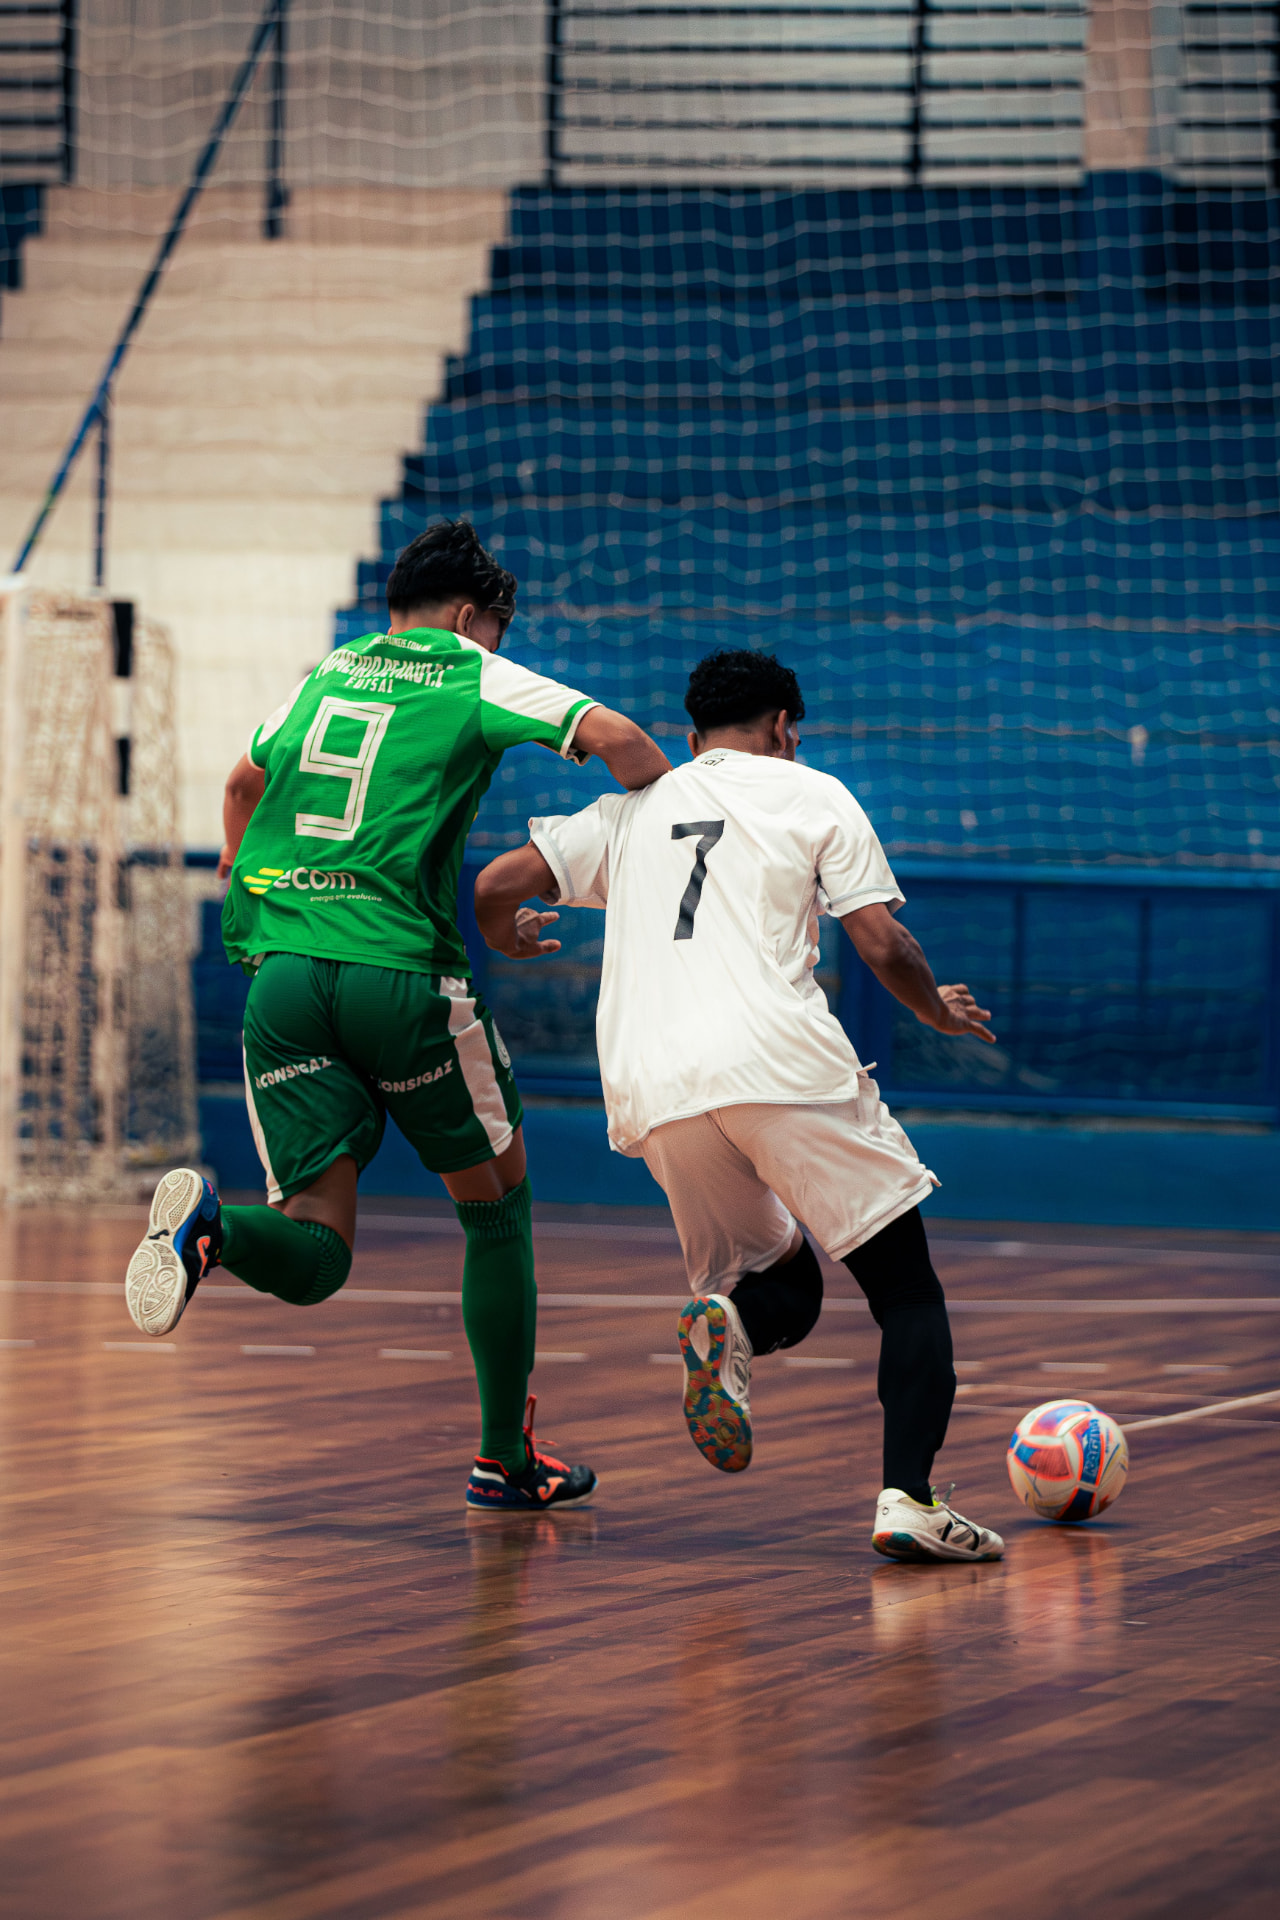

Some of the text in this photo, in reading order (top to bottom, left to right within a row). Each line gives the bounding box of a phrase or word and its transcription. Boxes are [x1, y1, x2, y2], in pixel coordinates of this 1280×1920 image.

[345, 676, 394, 693] FUTSAL
[295, 696, 397, 841] 9
[273, 867, 356, 890] ecom
[671, 819, 725, 941] 7
[260, 1056, 332, 1088] CONSIGAZ
[377, 1058, 454, 1093] ONSIGAZ
